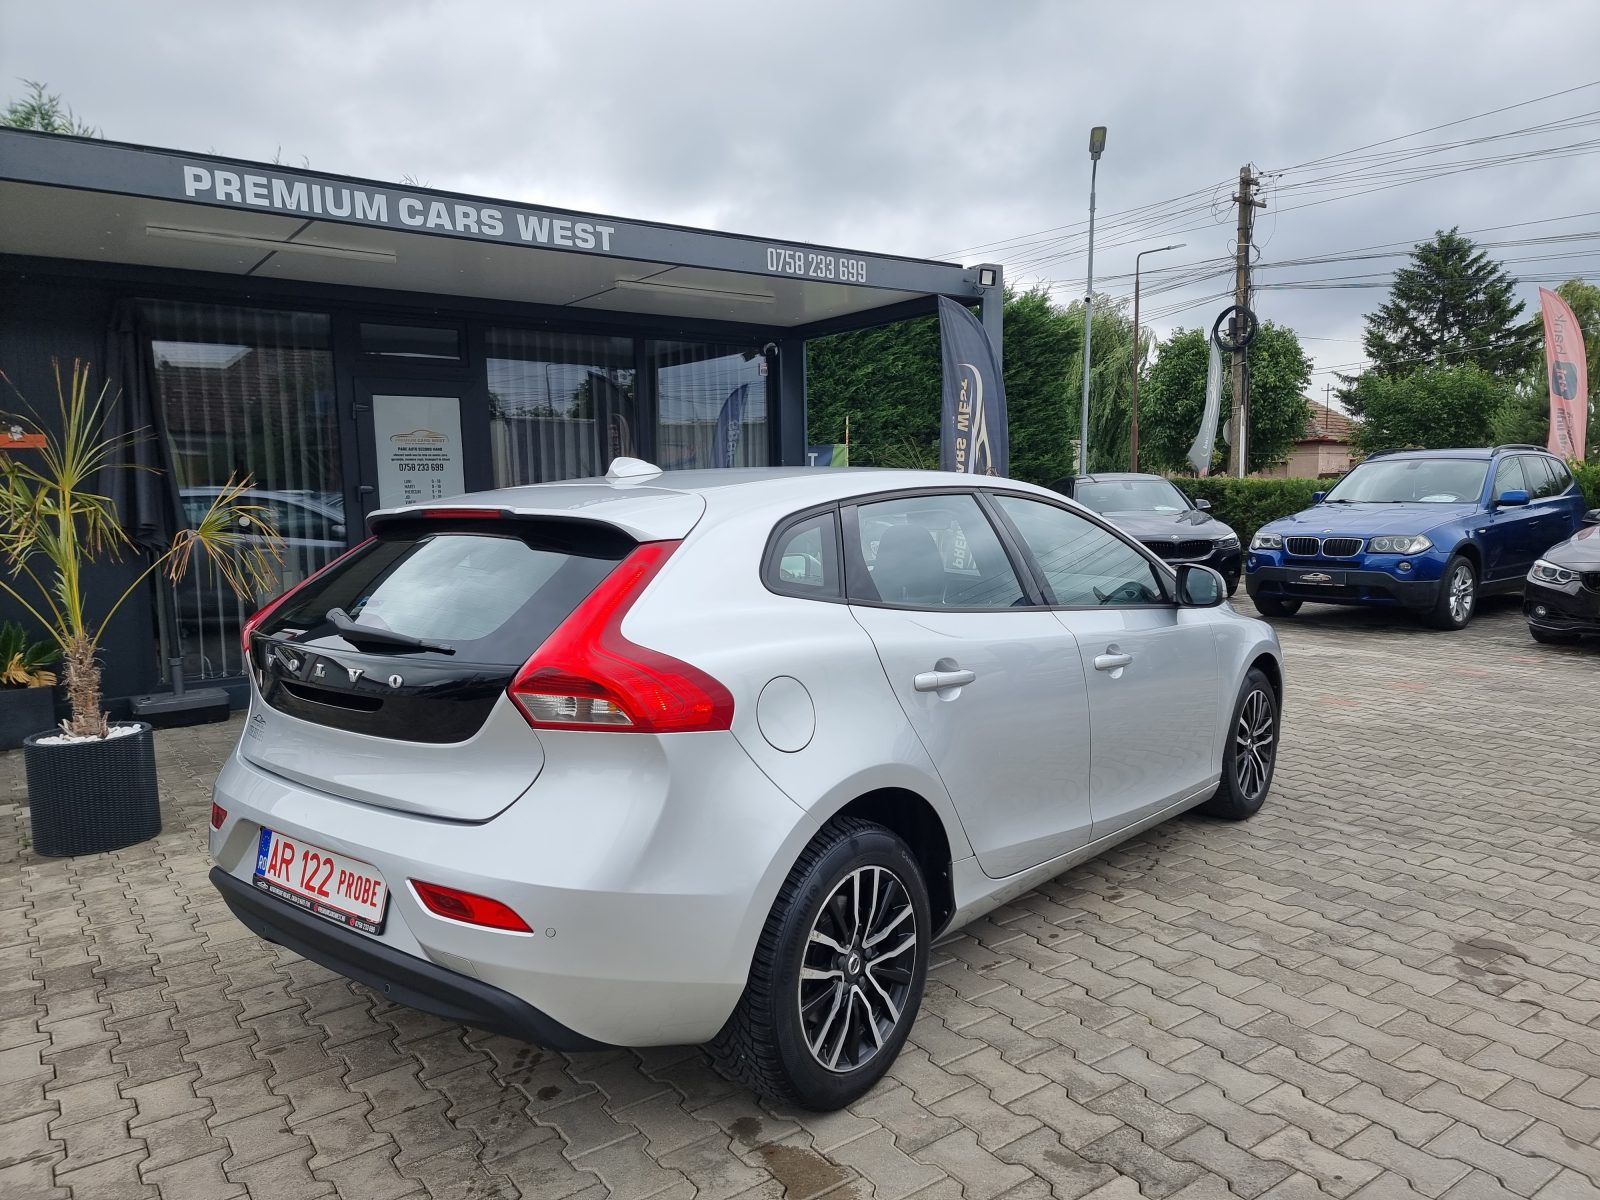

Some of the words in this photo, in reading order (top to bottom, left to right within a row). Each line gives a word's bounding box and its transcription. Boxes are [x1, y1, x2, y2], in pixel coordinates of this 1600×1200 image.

[183, 165, 389, 223] PREMIUM
[398, 197, 504, 236] CARS
[516, 214, 615, 251] WEST
[767, 248, 805, 275] 0758
[808, 253, 835, 279] 233
[839, 258, 867, 283] 699
[398, 463, 416, 471] 0758
[416, 463, 430, 471] 233
[430, 463, 444, 472] 699
[257, 854, 268, 871] RO
[267, 838, 295, 882] AR
[300, 849, 335, 898] 122
[337, 869, 382, 908] PROBE
